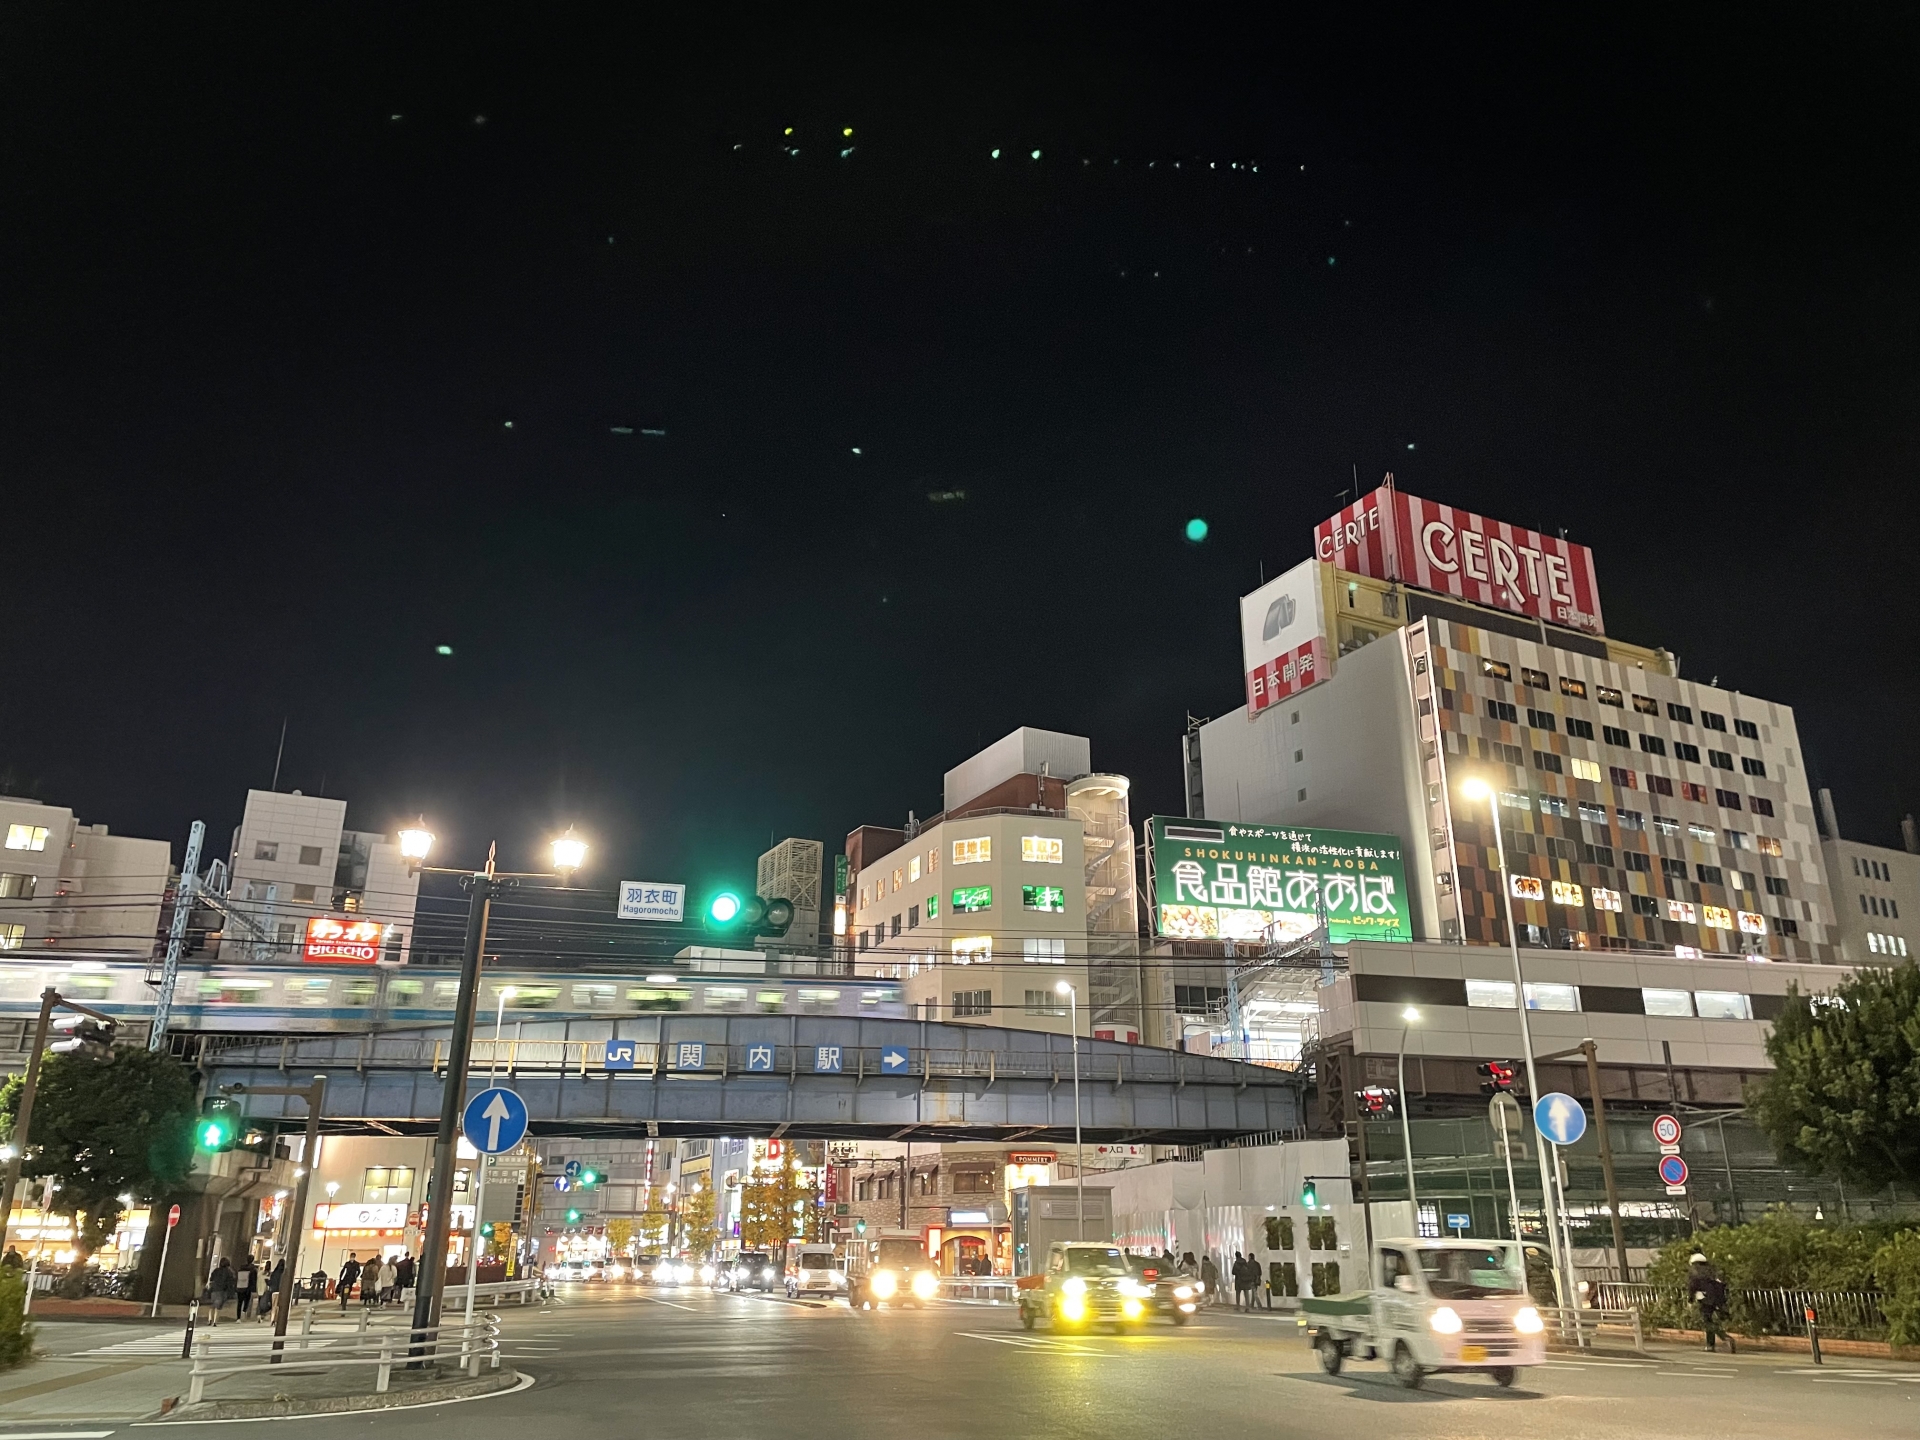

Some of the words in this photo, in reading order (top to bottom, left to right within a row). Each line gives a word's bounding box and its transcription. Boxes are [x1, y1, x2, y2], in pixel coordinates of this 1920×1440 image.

[1319, 506, 1379, 559] CERTE
[1422, 521, 1571, 604] CERTE
[1252, 653, 1315, 697] 日本開発
[1229, 825, 1312, 842] 食やスポーツを通じて
[1171, 860, 1397, 915] 食品館あおば
[626, 888, 678, 905] 羽衣町
[622, 904, 679, 916] Hagoromocho
[311, 921, 378, 942] カラオケ
[308, 945, 335, 956] BIG
[336, 946, 375, 960] ECHO
[607, 1048, 632, 1062] JR
[1659, 1123, 1675, 1137] 50
[1109, 1145, 1123, 1154] 入口
[487, 1156, 496, 1166] P
